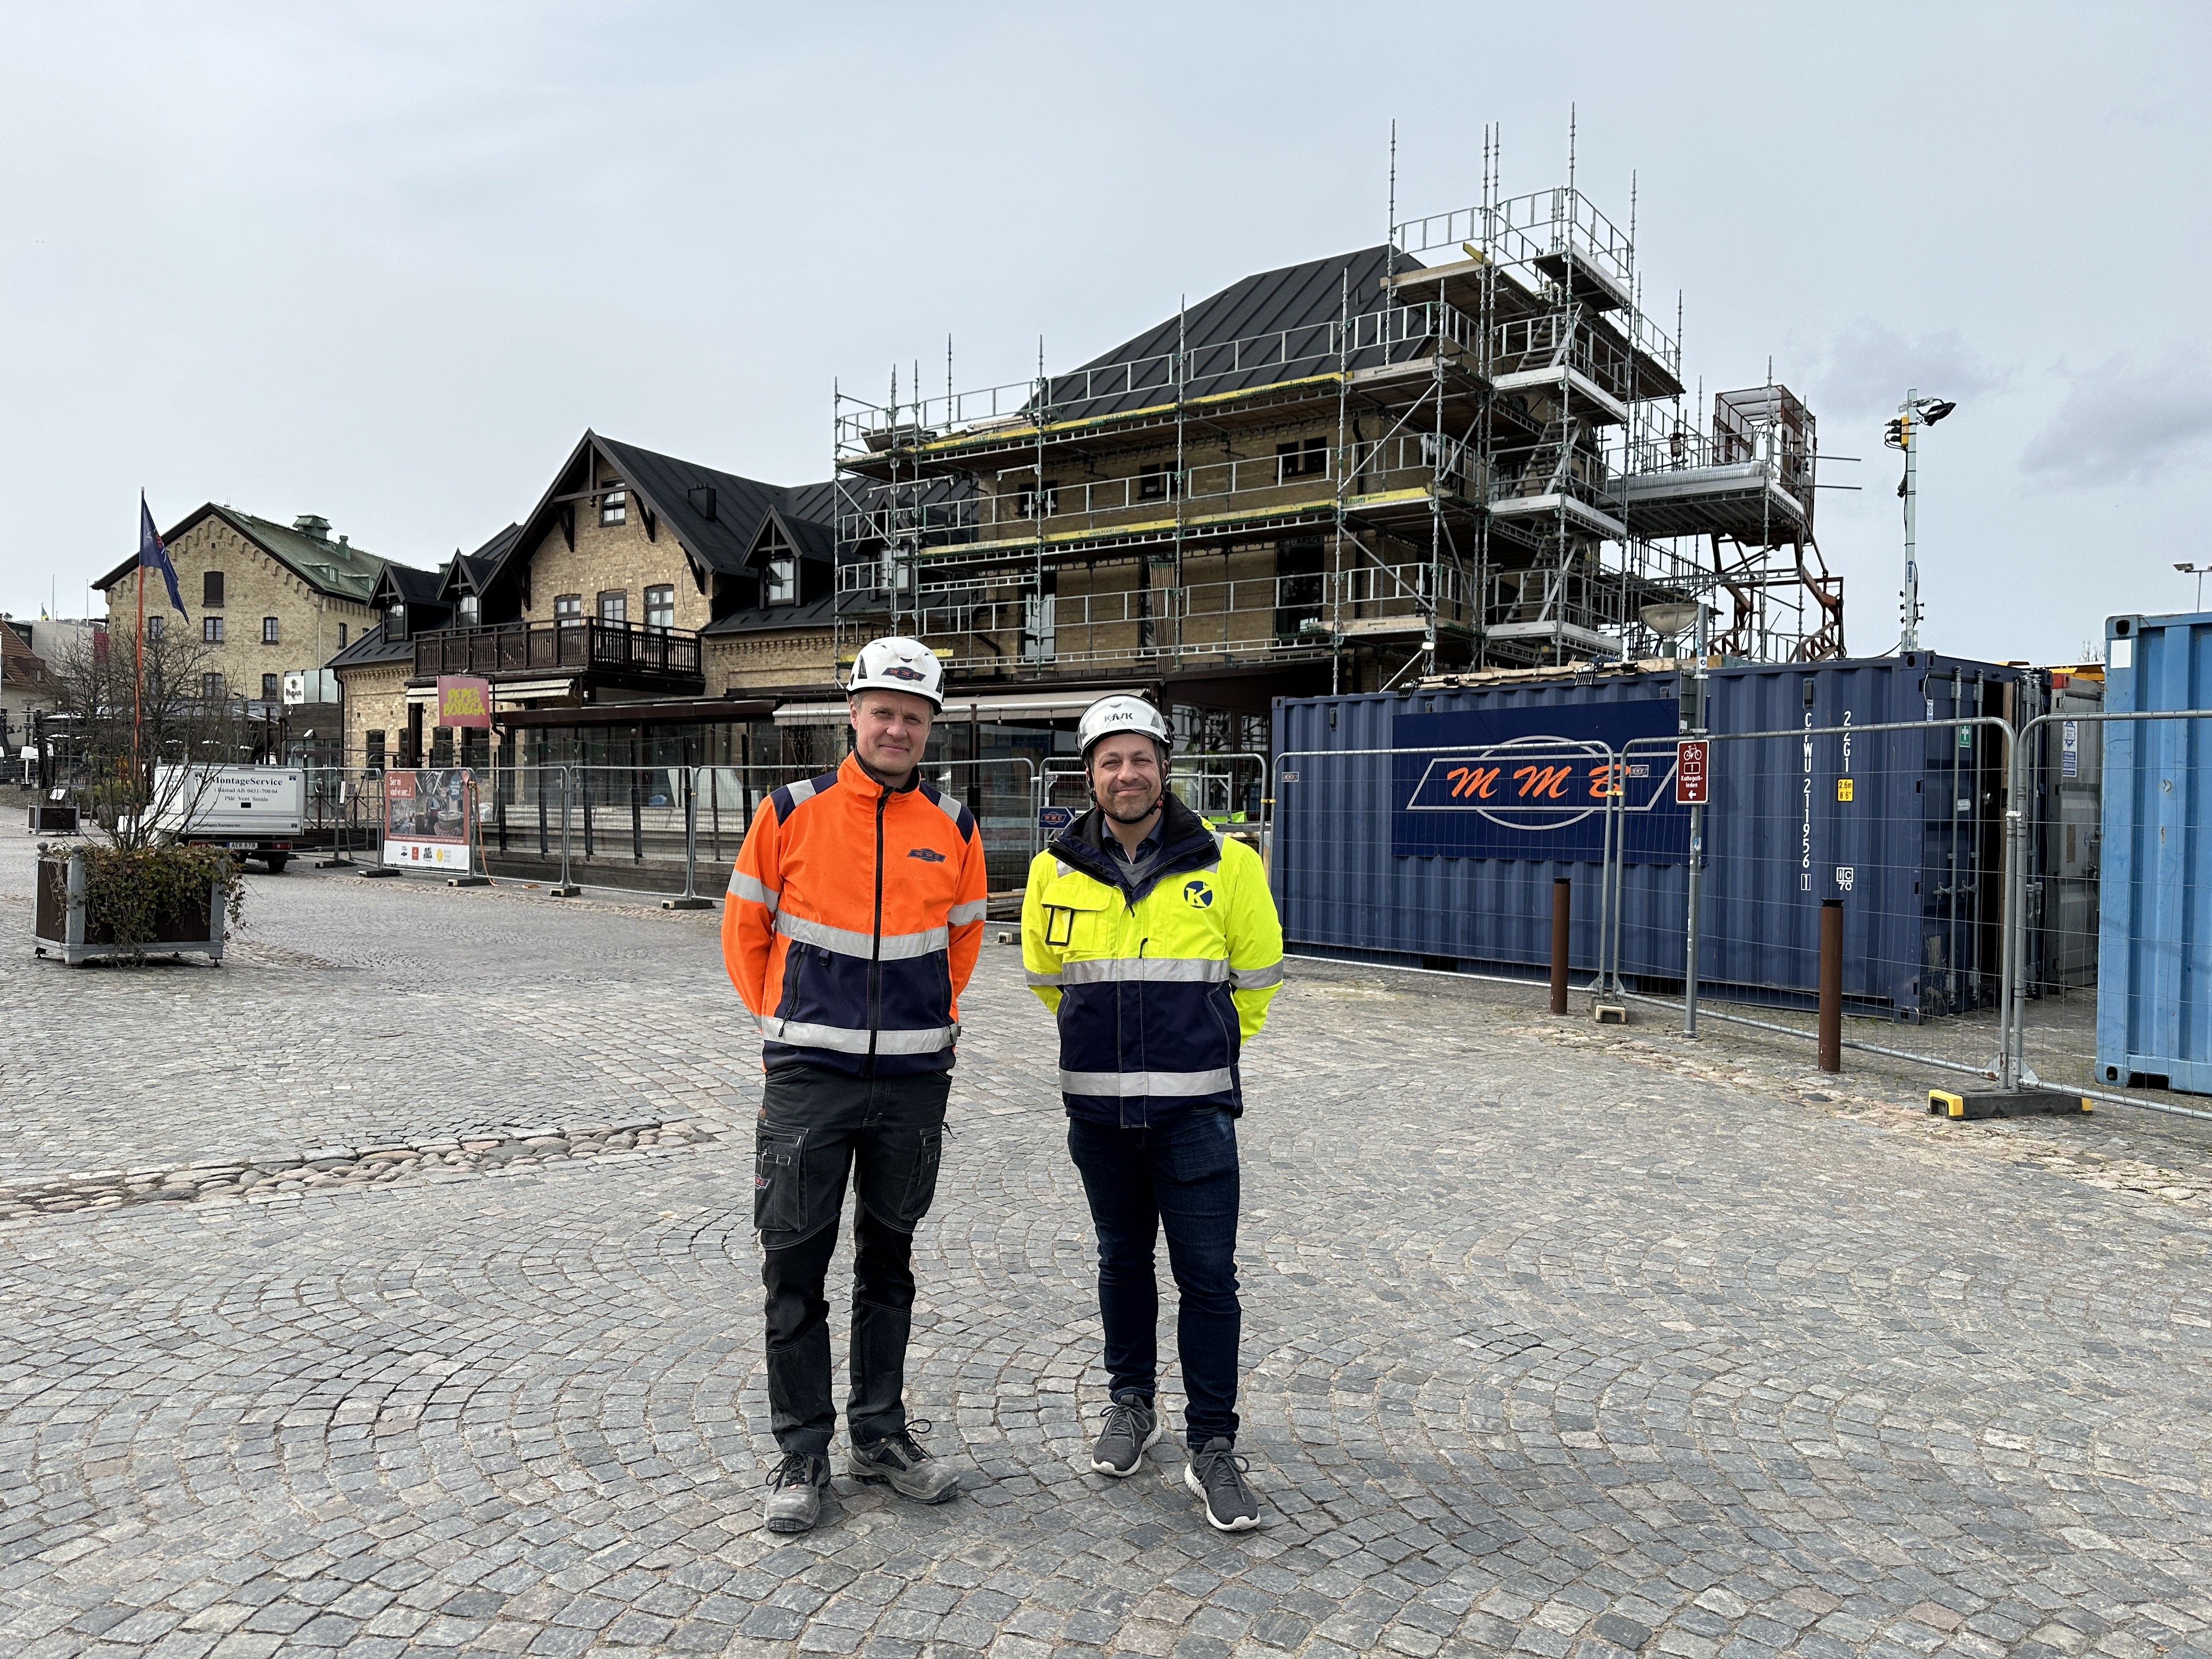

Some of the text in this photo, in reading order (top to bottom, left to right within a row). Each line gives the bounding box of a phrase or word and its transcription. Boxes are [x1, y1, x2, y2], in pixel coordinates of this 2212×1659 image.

[443, 702, 486, 716] BODEGA
[1104, 713, 1133, 723] KASK
[1838, 882, 1852, 891] 70
